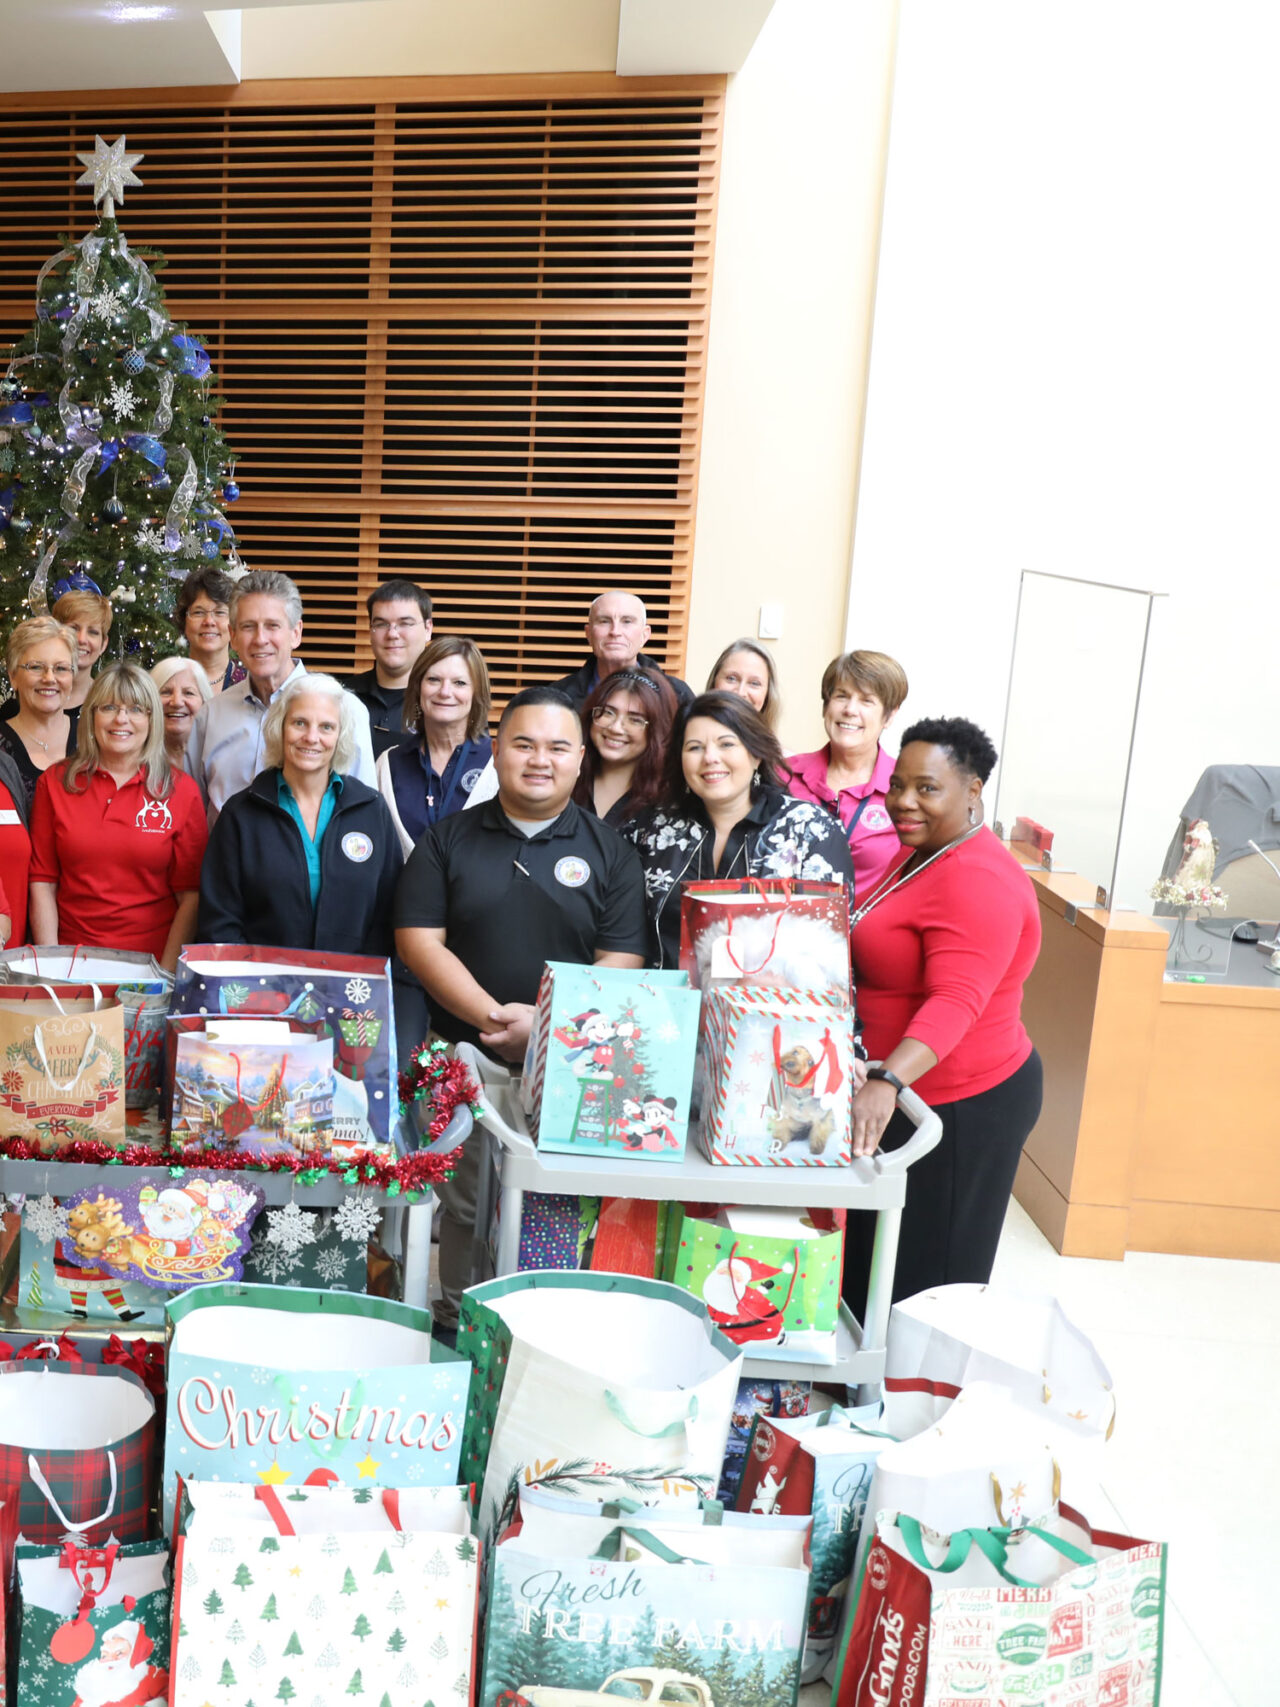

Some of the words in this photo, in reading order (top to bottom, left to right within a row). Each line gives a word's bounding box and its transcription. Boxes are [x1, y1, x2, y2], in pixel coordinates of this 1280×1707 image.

[39, 1105, 81, 1116] EVERYONE
[177, 1376, 458, 1451] Christmas
[520, 1568, 646, 1611] Fresh
[514, 1602, 639, 1646] TREE
[653, 1616, 786, 1651] FARM
[870, 1606, 905, 1707] Goods
